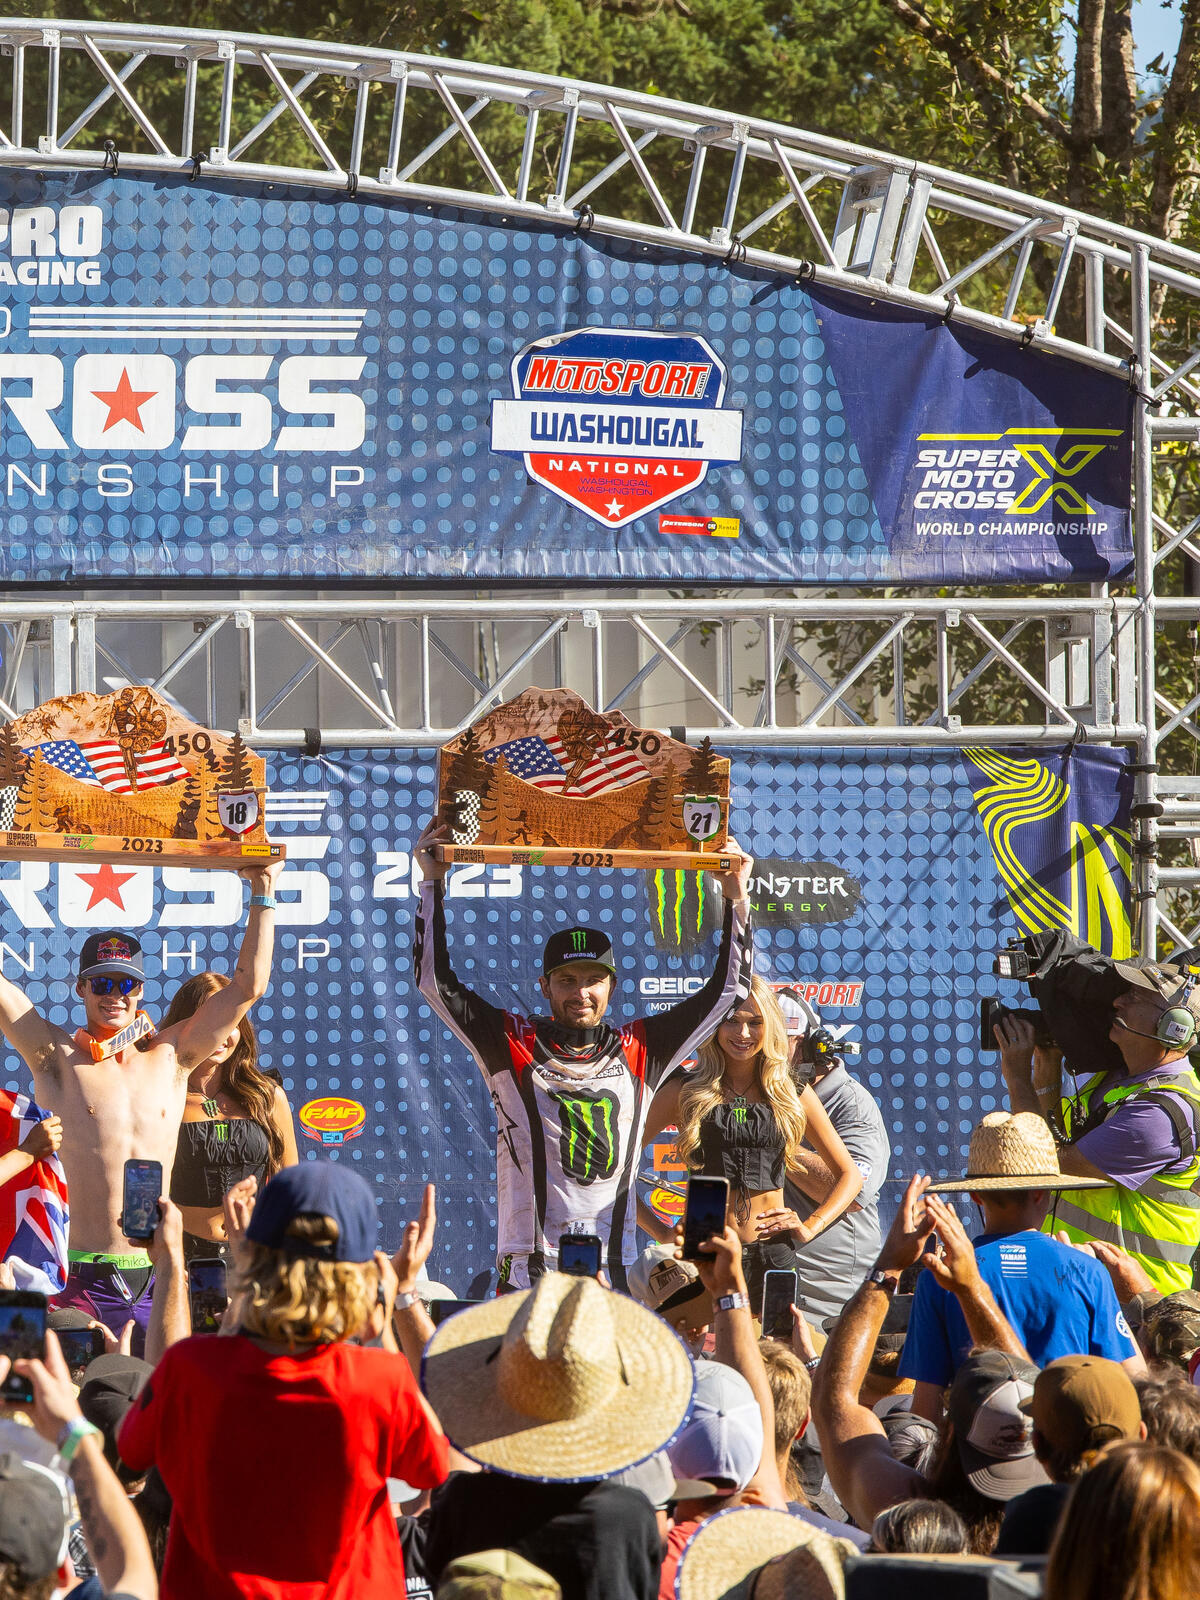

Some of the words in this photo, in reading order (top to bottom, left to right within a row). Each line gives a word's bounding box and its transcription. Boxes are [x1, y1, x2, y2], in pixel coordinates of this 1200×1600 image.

[531, 411, 704, 449] WASHOUGAL
[915, 449, 1023, 467] SUPER
[548, 459, 684, 477] NATIONAL
[580, 477, 651, 488] WASHOUGAL
[921, 470, 1016, 488] MOTO
[578, 486, 653, 496] WASHINGTON
[913, 491, 1017, 509] CROSS
[916, 523, 975, 535] WORLD
[978, 522, 1109, 535] CHAMPIONSHIP
[161, 732, 211, 757] 450
[608, 728, 662, 755] 450
[225, 801, 247, 825] 18
[445, 790, 481, 845] 3
[690, 812, 713, 834] 21
[121, 837, 164, 853] 2023
[571, 852, 614, 867] 2023
[373, 851, 524, 898] 223
[750, 903, 827, 912] NERGY
[639, 977, 709, 994] GEIC
[306, 1106, 360, 1119] FMF
[1000, 1253, 1027, 1261] YAMAHA
